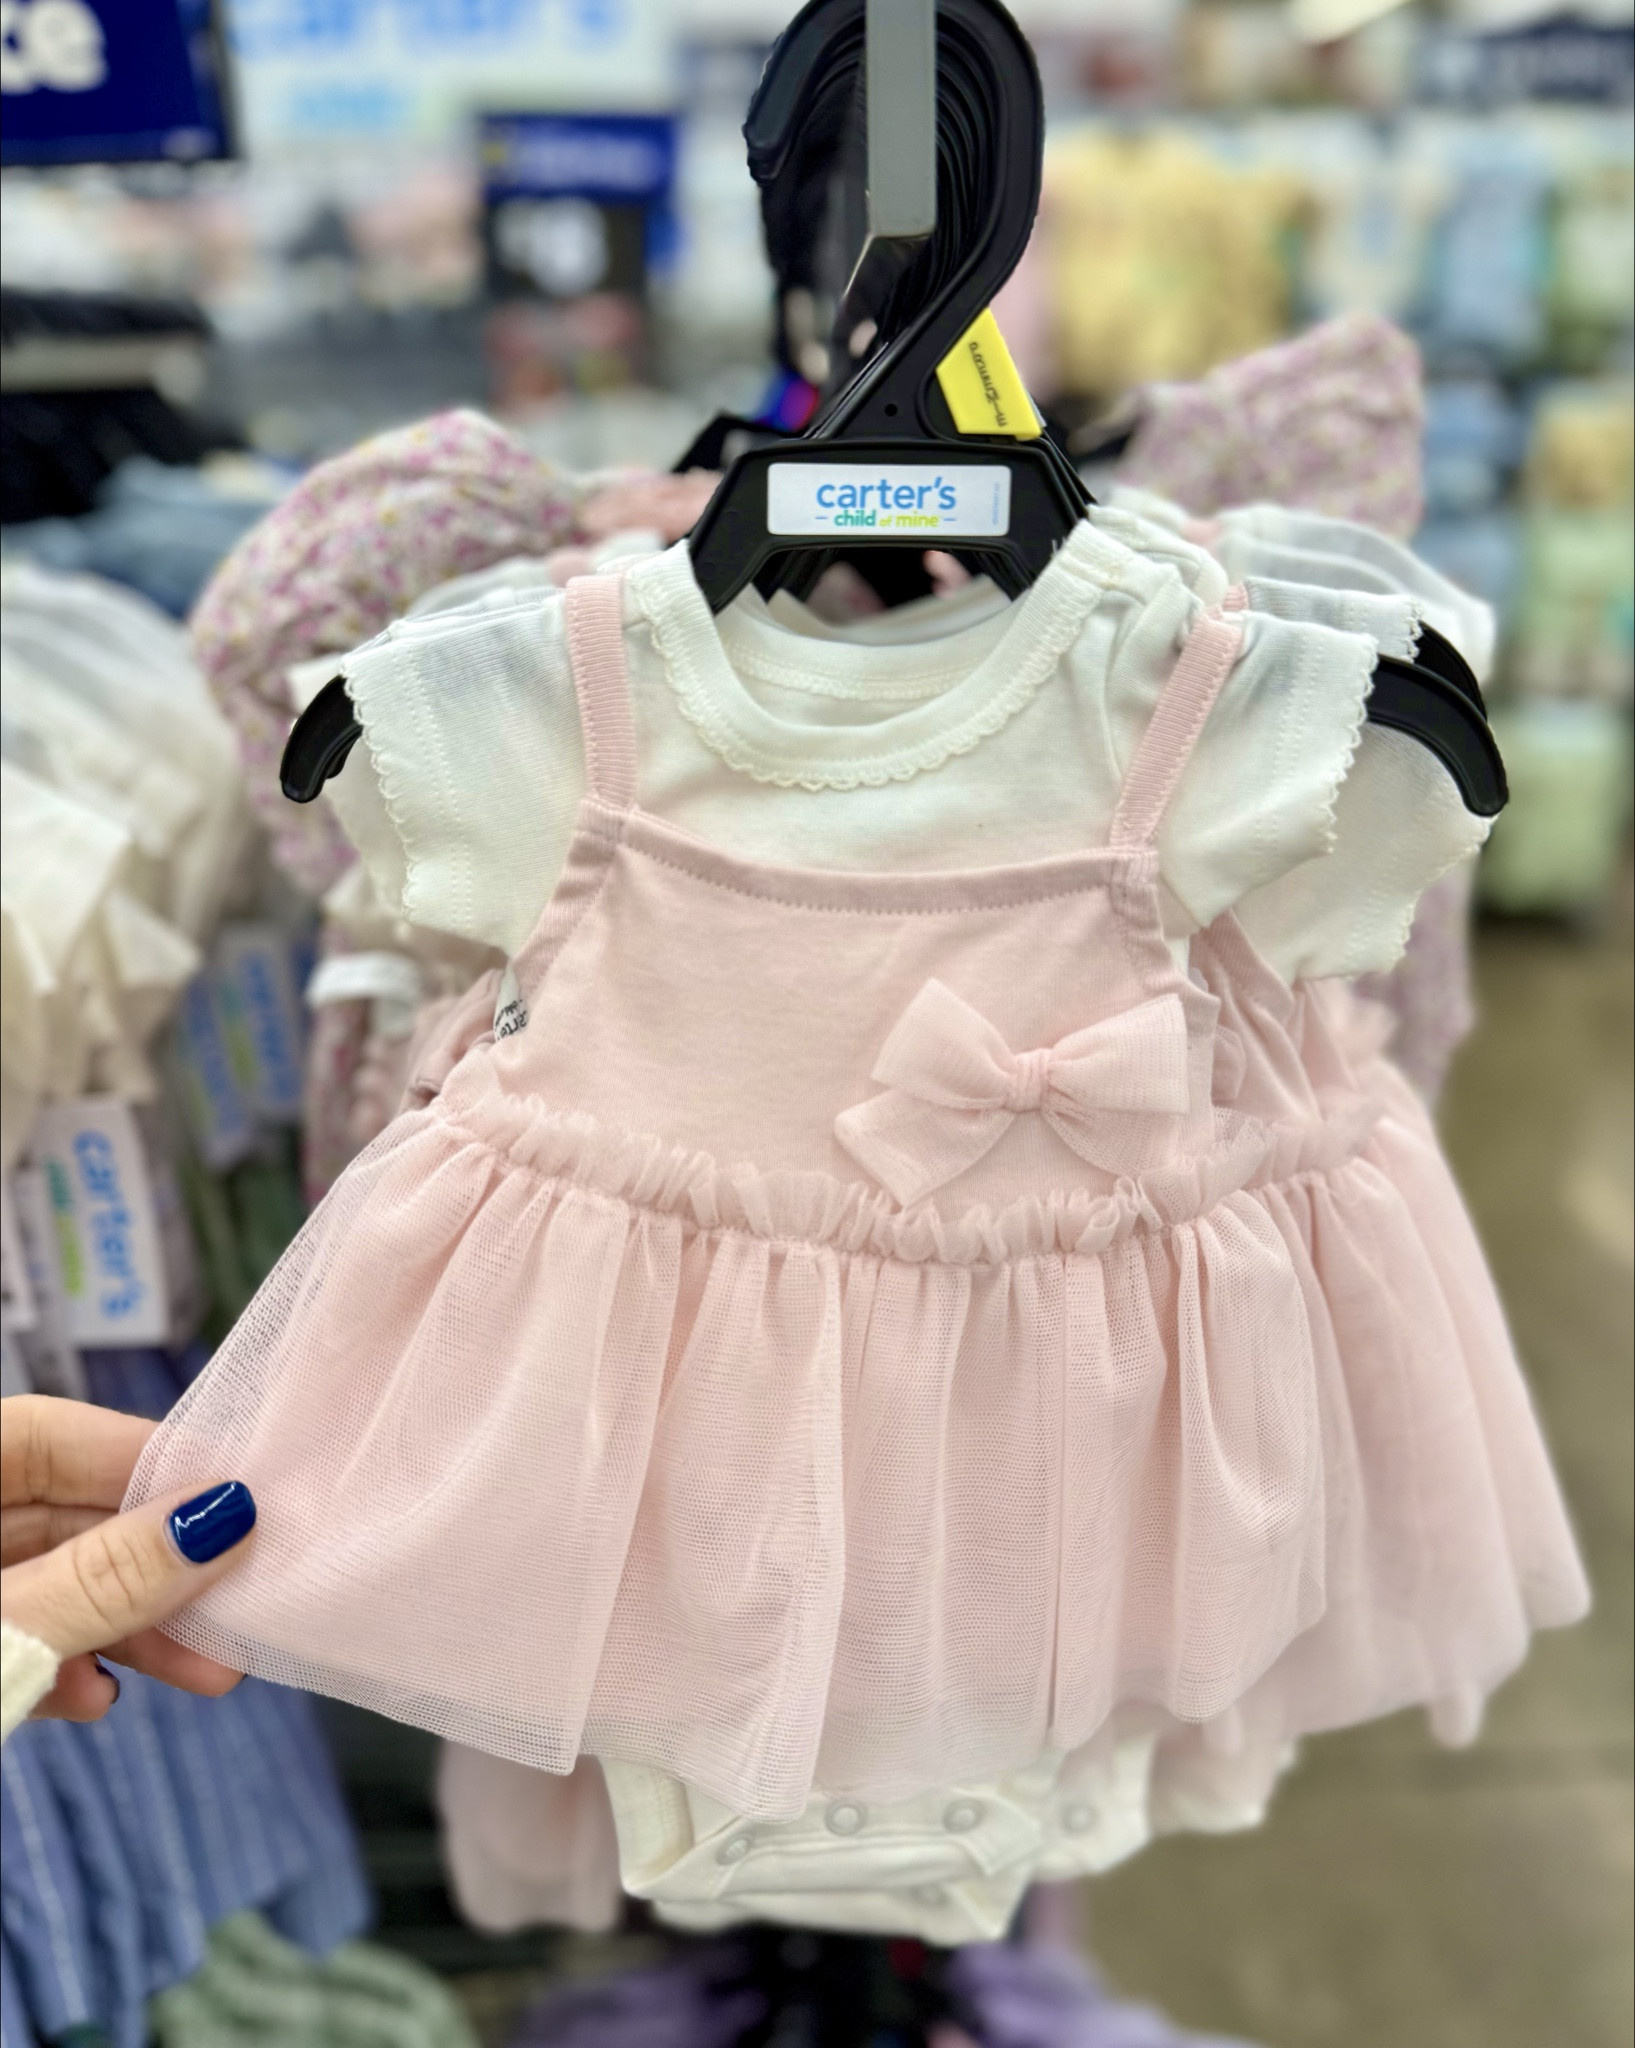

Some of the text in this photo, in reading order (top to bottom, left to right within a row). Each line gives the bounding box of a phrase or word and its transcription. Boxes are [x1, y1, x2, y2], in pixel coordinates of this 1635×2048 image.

[816, 476, 957, 510] carter's
[834, 509, 940, 528] child of mine
